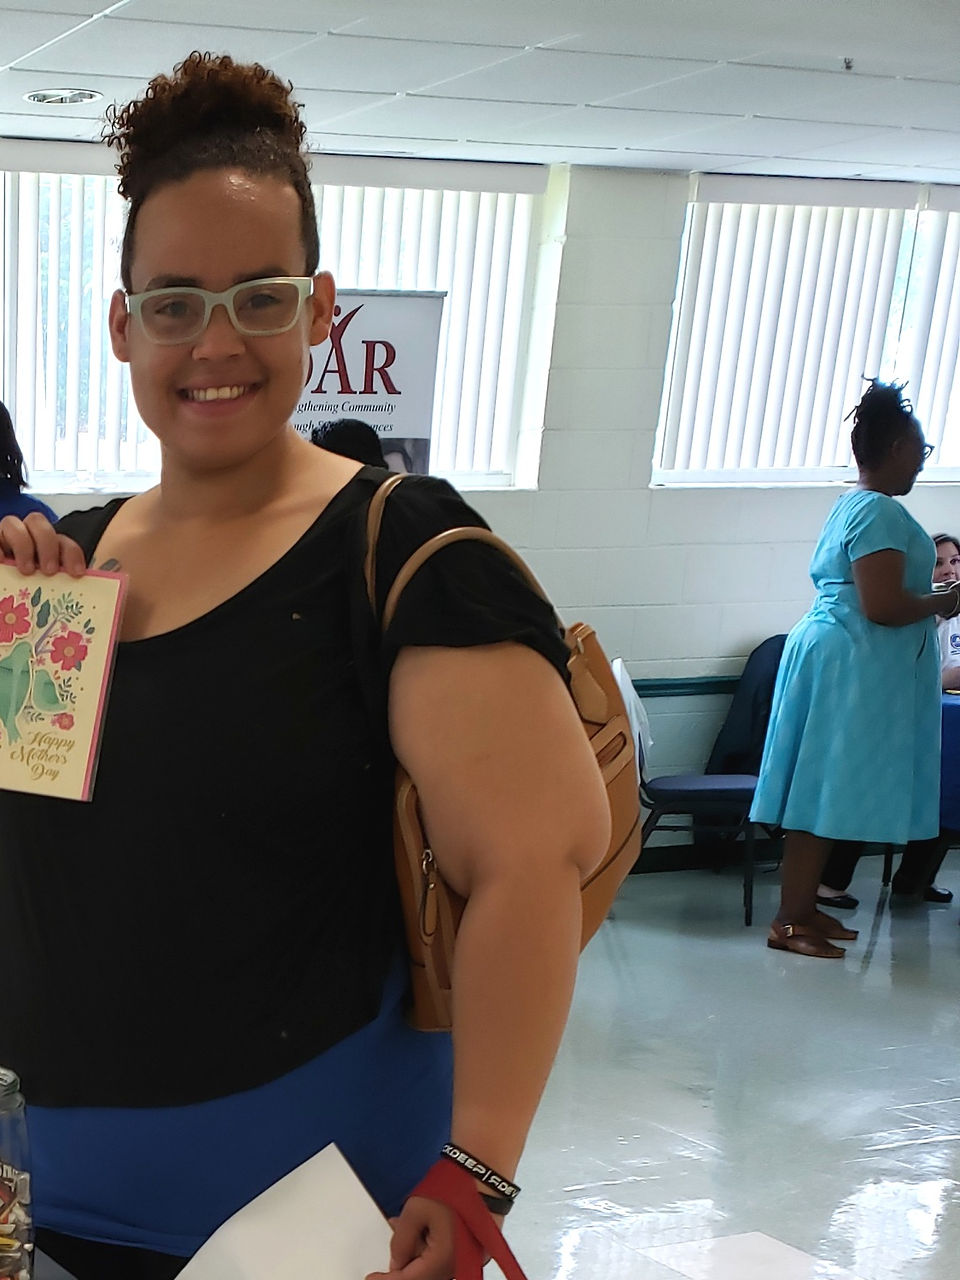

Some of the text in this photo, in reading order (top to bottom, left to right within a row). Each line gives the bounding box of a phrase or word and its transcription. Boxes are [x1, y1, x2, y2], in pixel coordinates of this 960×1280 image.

[341, 401, 396, 415] Community
[28, 730, 76, 750] Happy
[9, 745, 68, 767] Mother's
[30, 764, 60, 781] Day
